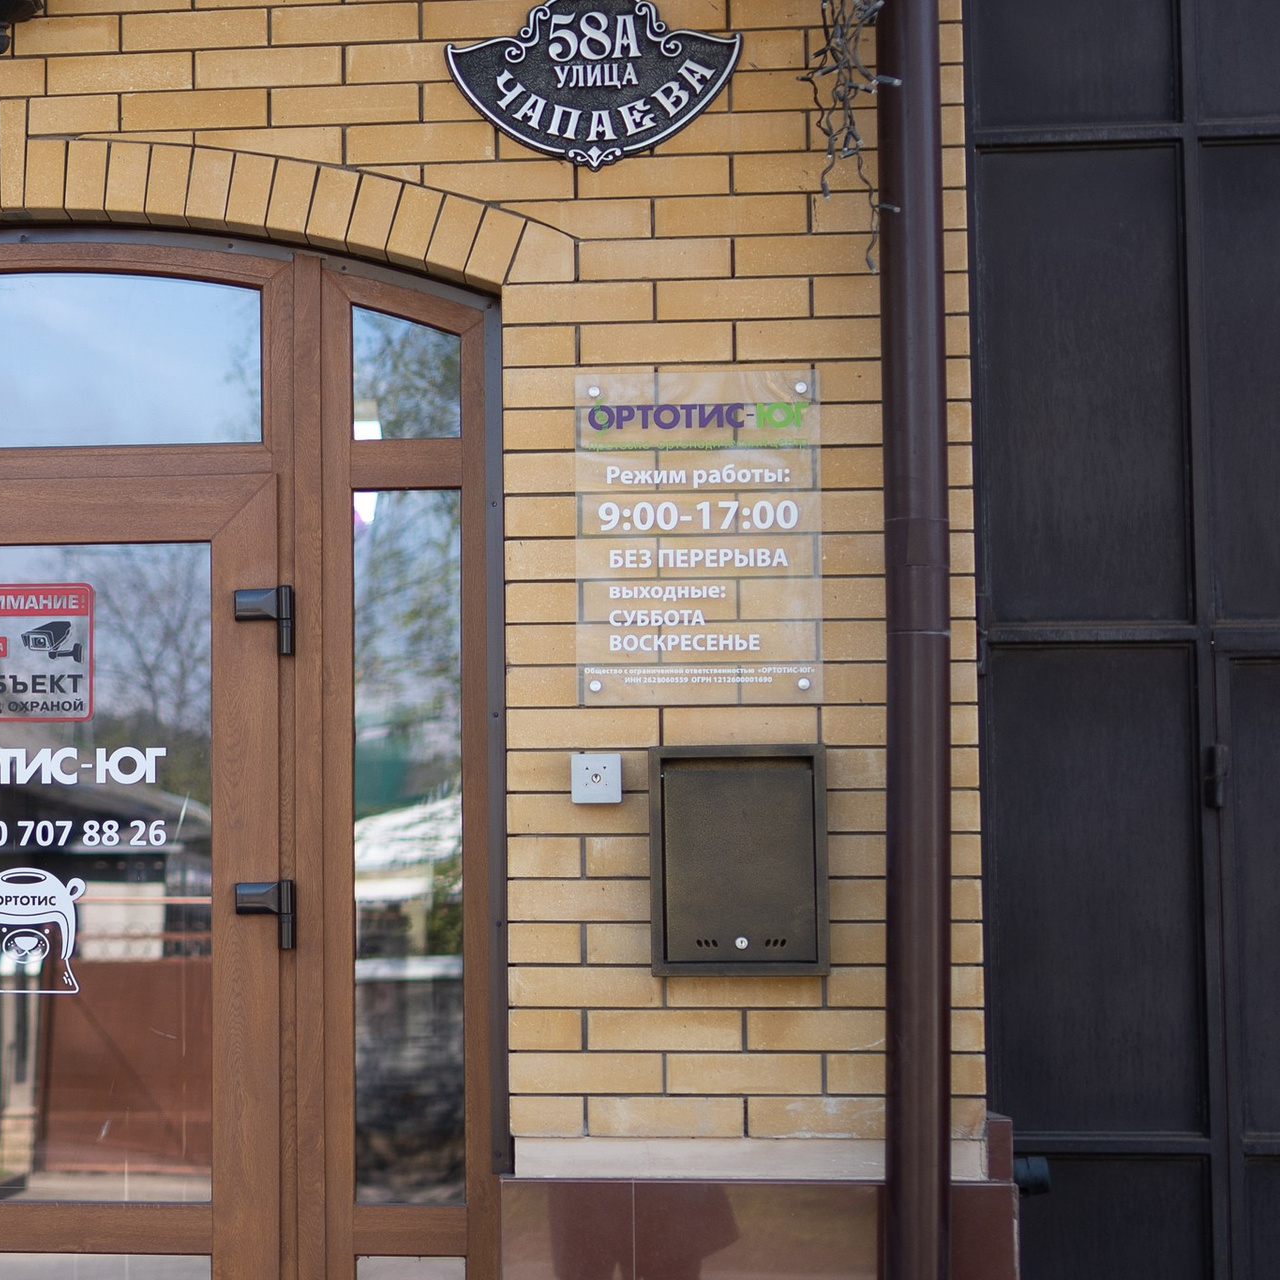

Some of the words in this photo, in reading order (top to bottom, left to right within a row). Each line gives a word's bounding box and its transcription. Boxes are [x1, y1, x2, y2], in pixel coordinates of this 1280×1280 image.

[548, 11, 642, 62] 58А
[553, 62, 639, 89] УЛИЦА
[495, 59, 716, 142] ЧАПАЕВА
[588, 401, 810, 431] ОРТОТИС-ЮГ
[606, 465, 686, 484] Режим
[693, 464, 791, 488] работы:
[597, 500, 799, 531] 9:00-17:00
[609, 549, 653, 568] БЕЗ
[658, 548, 788, 567] ПЕРЕРЫВА
[609, 585, 726, 601] выходные:
[609, 609, 706, 627] СУББОТА
[609, 634, 760, 652] ВОСКРЕСЕНЬЕ
[584, 667, 622, 675] Общество
[629, 667, 684, 675] ограниченной
[8, 698, 83, 712] ОХРАНОЙ
[17, 820, 73, 847] 707
[82, 819, 120, 847] 88
[129, 819, 167, 846] 26
